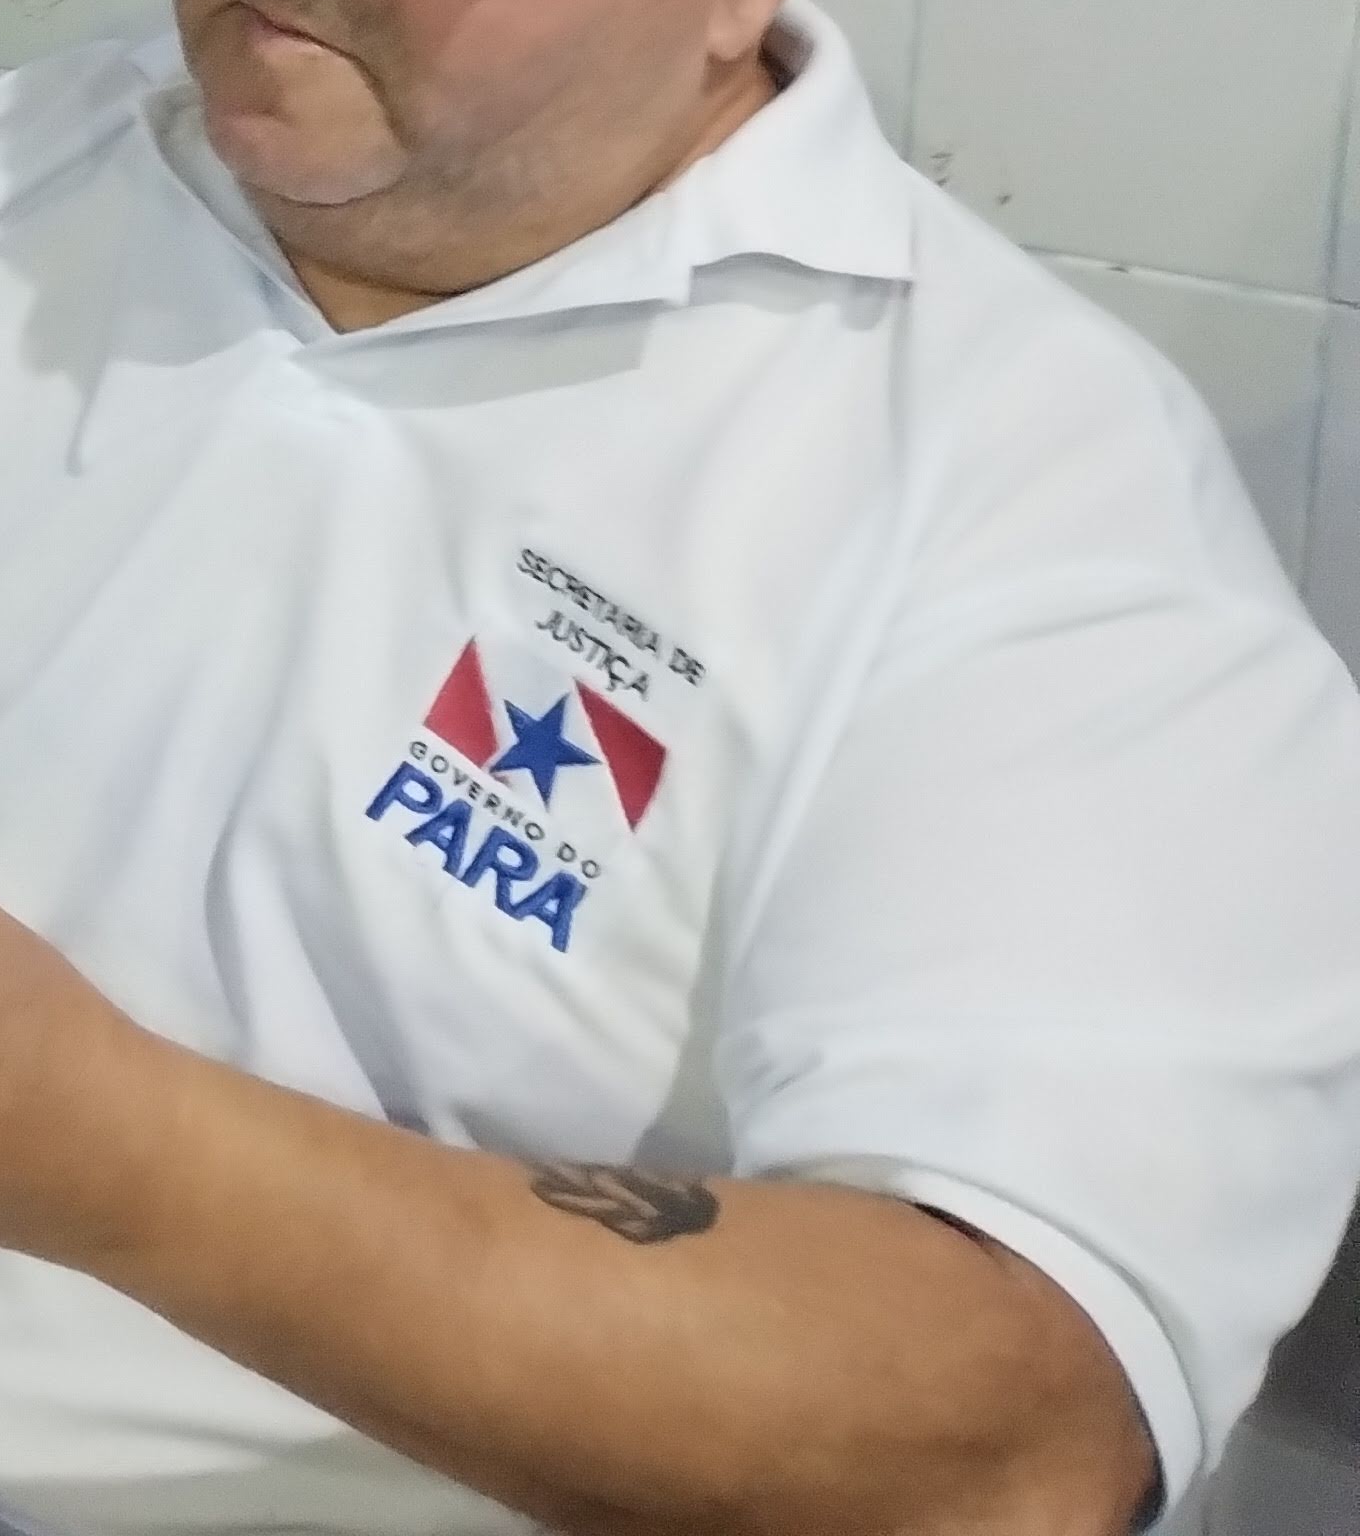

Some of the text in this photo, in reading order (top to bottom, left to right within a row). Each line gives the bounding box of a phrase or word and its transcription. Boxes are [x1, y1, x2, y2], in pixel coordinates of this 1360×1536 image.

[516, 548, 707, 688] SECRETARIA DE
[534, 609, 650, 703] JUSTIÇA
[408, 740, 603, 880] GOVERNO DO
